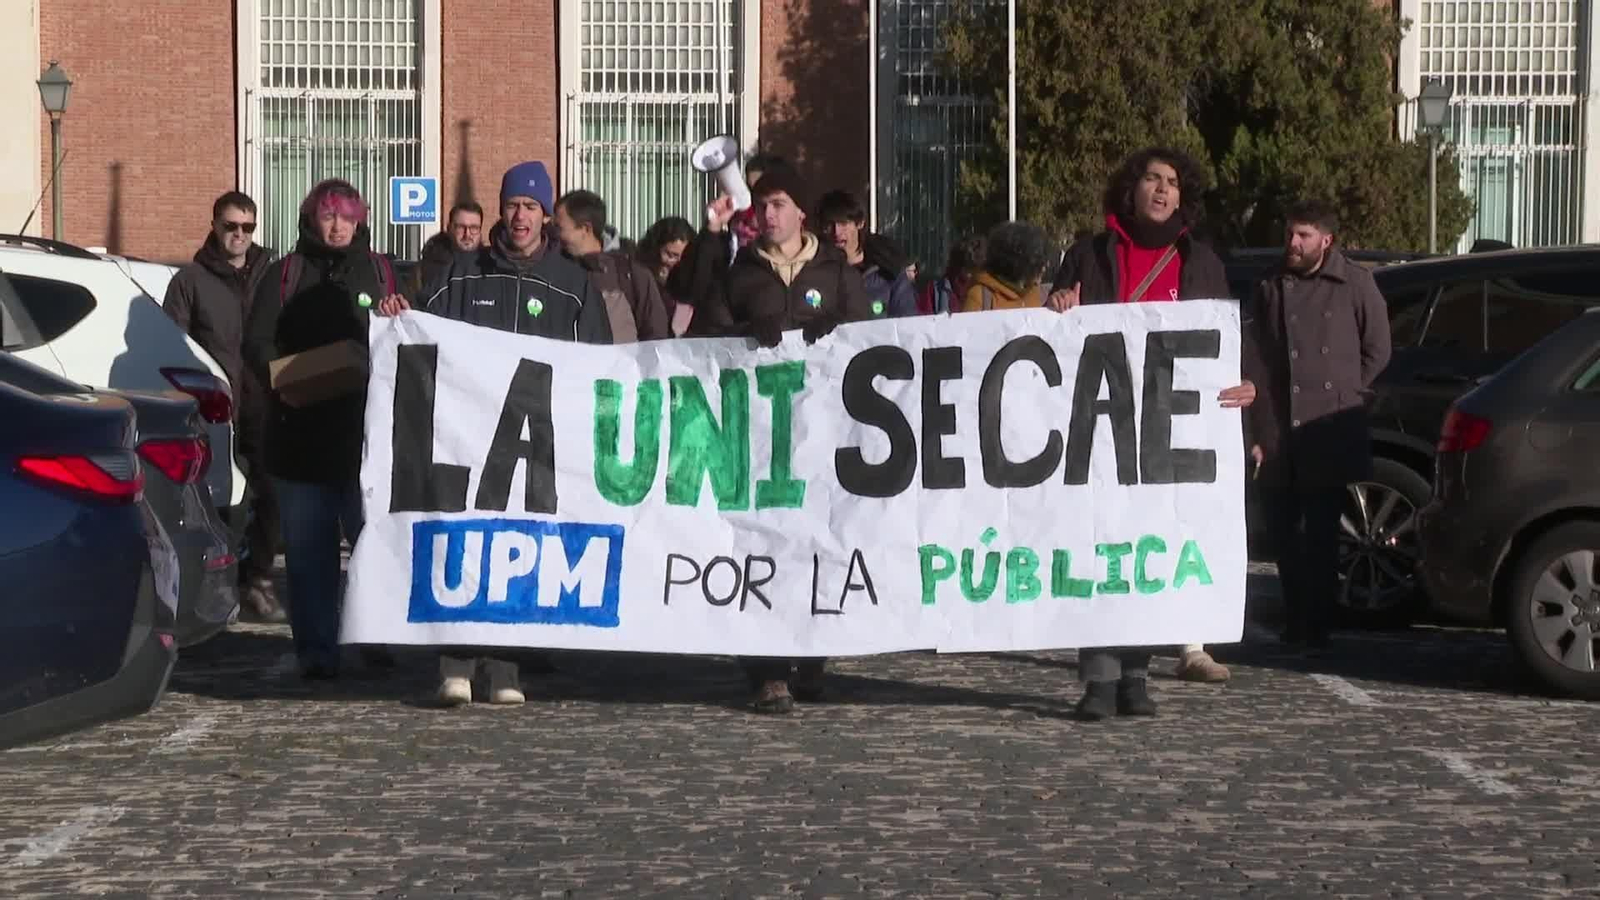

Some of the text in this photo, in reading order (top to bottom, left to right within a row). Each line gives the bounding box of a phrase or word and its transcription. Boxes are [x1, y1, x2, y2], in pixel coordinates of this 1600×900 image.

[400, 183, 428, 217] P
[389, 344, 558, 514] LA
[593, 360, 807, 511] UNI
[431, 526, 1214, 617] UPM POR LA PÚBLICA
